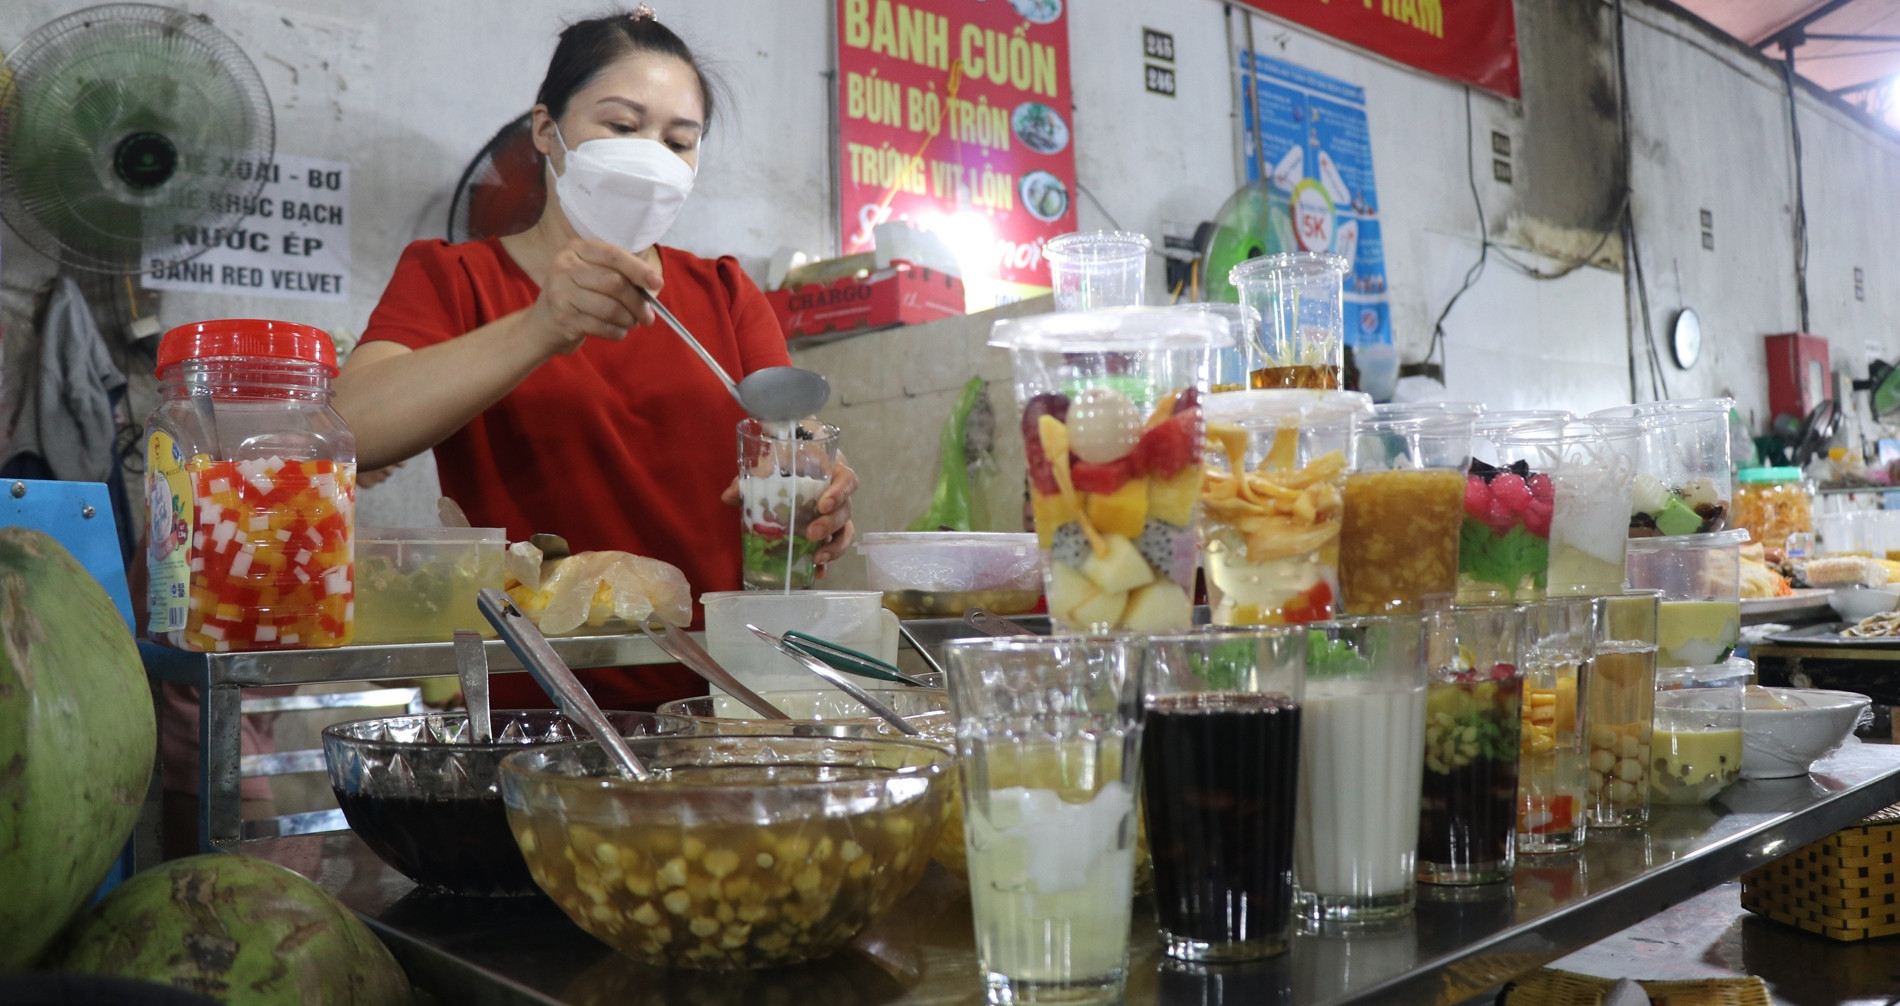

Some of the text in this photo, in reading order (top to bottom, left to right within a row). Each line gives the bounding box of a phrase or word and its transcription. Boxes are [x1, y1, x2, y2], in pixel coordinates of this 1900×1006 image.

[959, 21, 1057, 97] CUỐN
[847, 68, 1010, 157] BÚN BÒ TRỘN
[307, 168, 343, 191] BƠ
[847, 141, 927, 196] TRỨNG
[969, 163, 1014, 215] LỘN
[281, 199, 343, 227] BẠCH
[1304, 214, 1327, 241] 5K
[282, 231, 324, 257] ÉP
[221, 265, 264, 288] RED
[270, 269, 343, 294] VELVET
